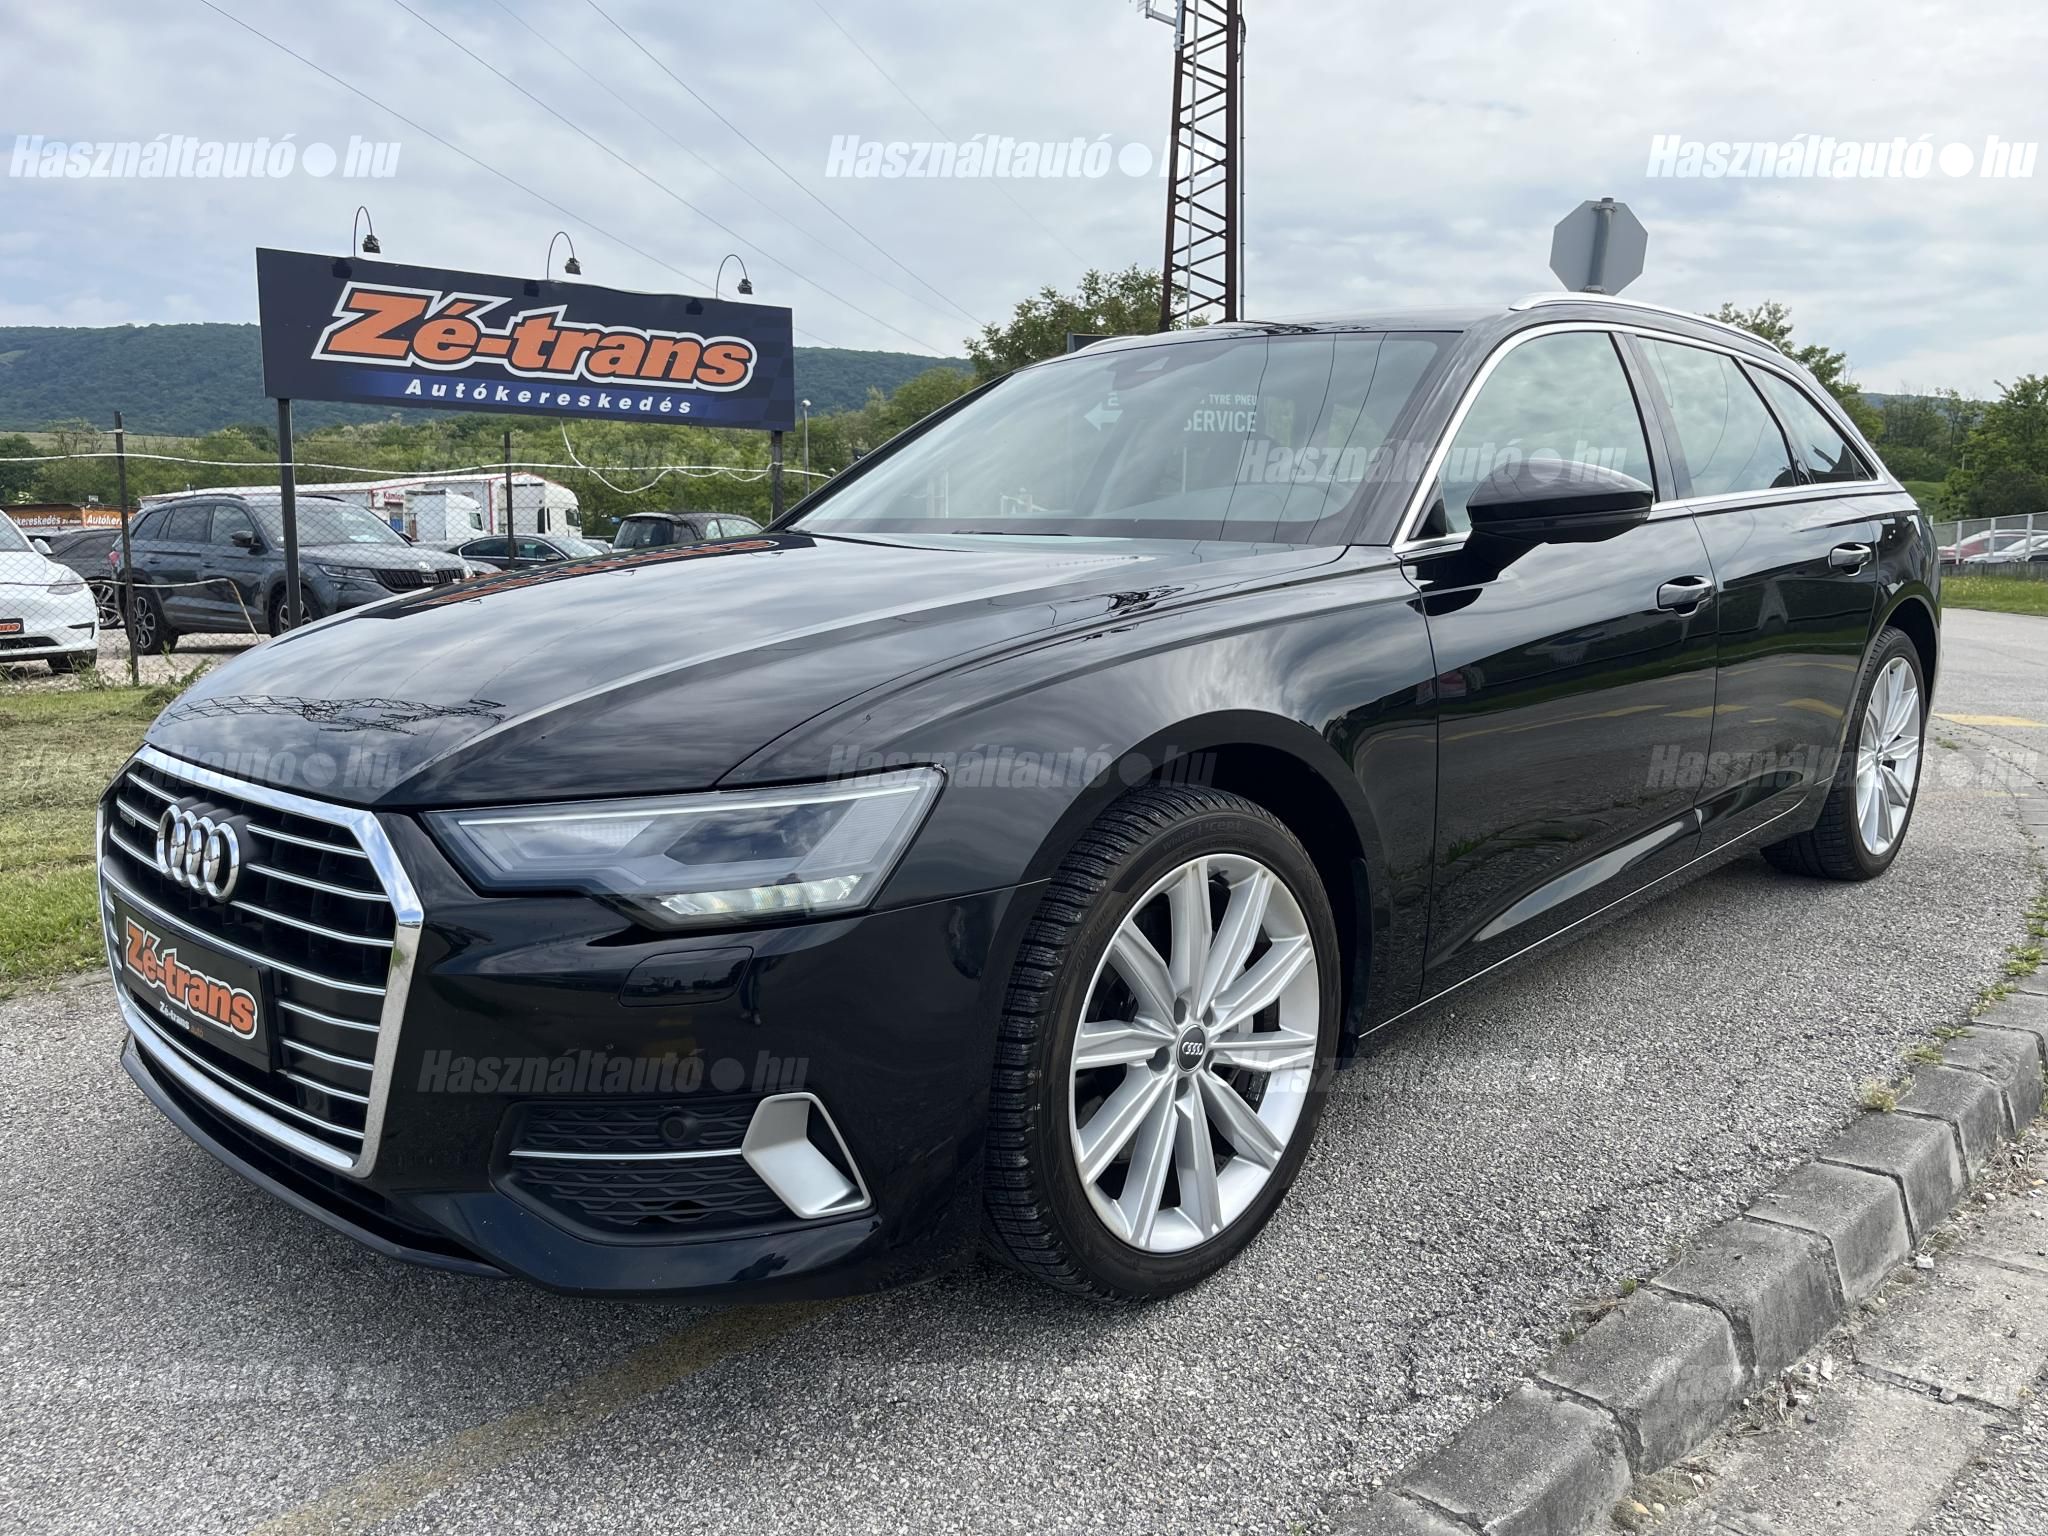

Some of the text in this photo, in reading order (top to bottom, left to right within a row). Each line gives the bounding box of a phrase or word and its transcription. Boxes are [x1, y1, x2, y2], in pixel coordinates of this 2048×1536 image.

[311, 281, 757, 392] Zé-trans
[405, 379, 691, 413] Autókereskedés
[1208, 394, 1231, 405] TYRE
[126, 916, 258, 1040] Zé-trans
